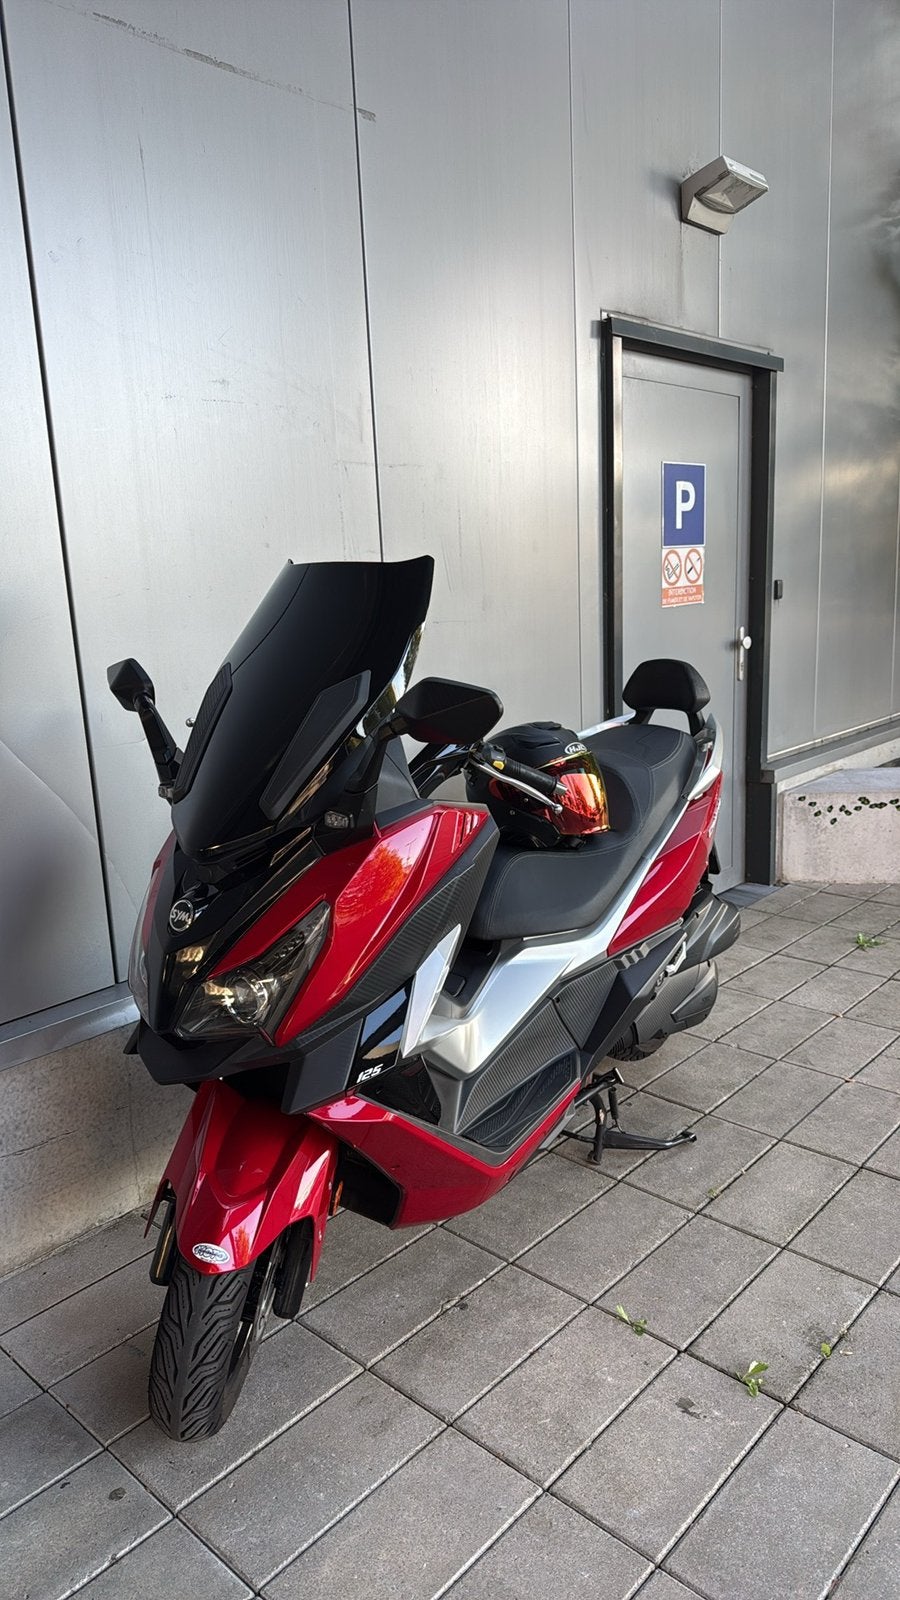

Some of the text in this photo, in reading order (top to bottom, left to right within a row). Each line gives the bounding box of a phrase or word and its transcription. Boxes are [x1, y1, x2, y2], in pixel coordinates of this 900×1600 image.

[675, 481, 696, 529] P
[568, 744, 587, 753] HJC
[170, 909, 190, 922] SYM
[356, 1063, 383, 1083] 125
